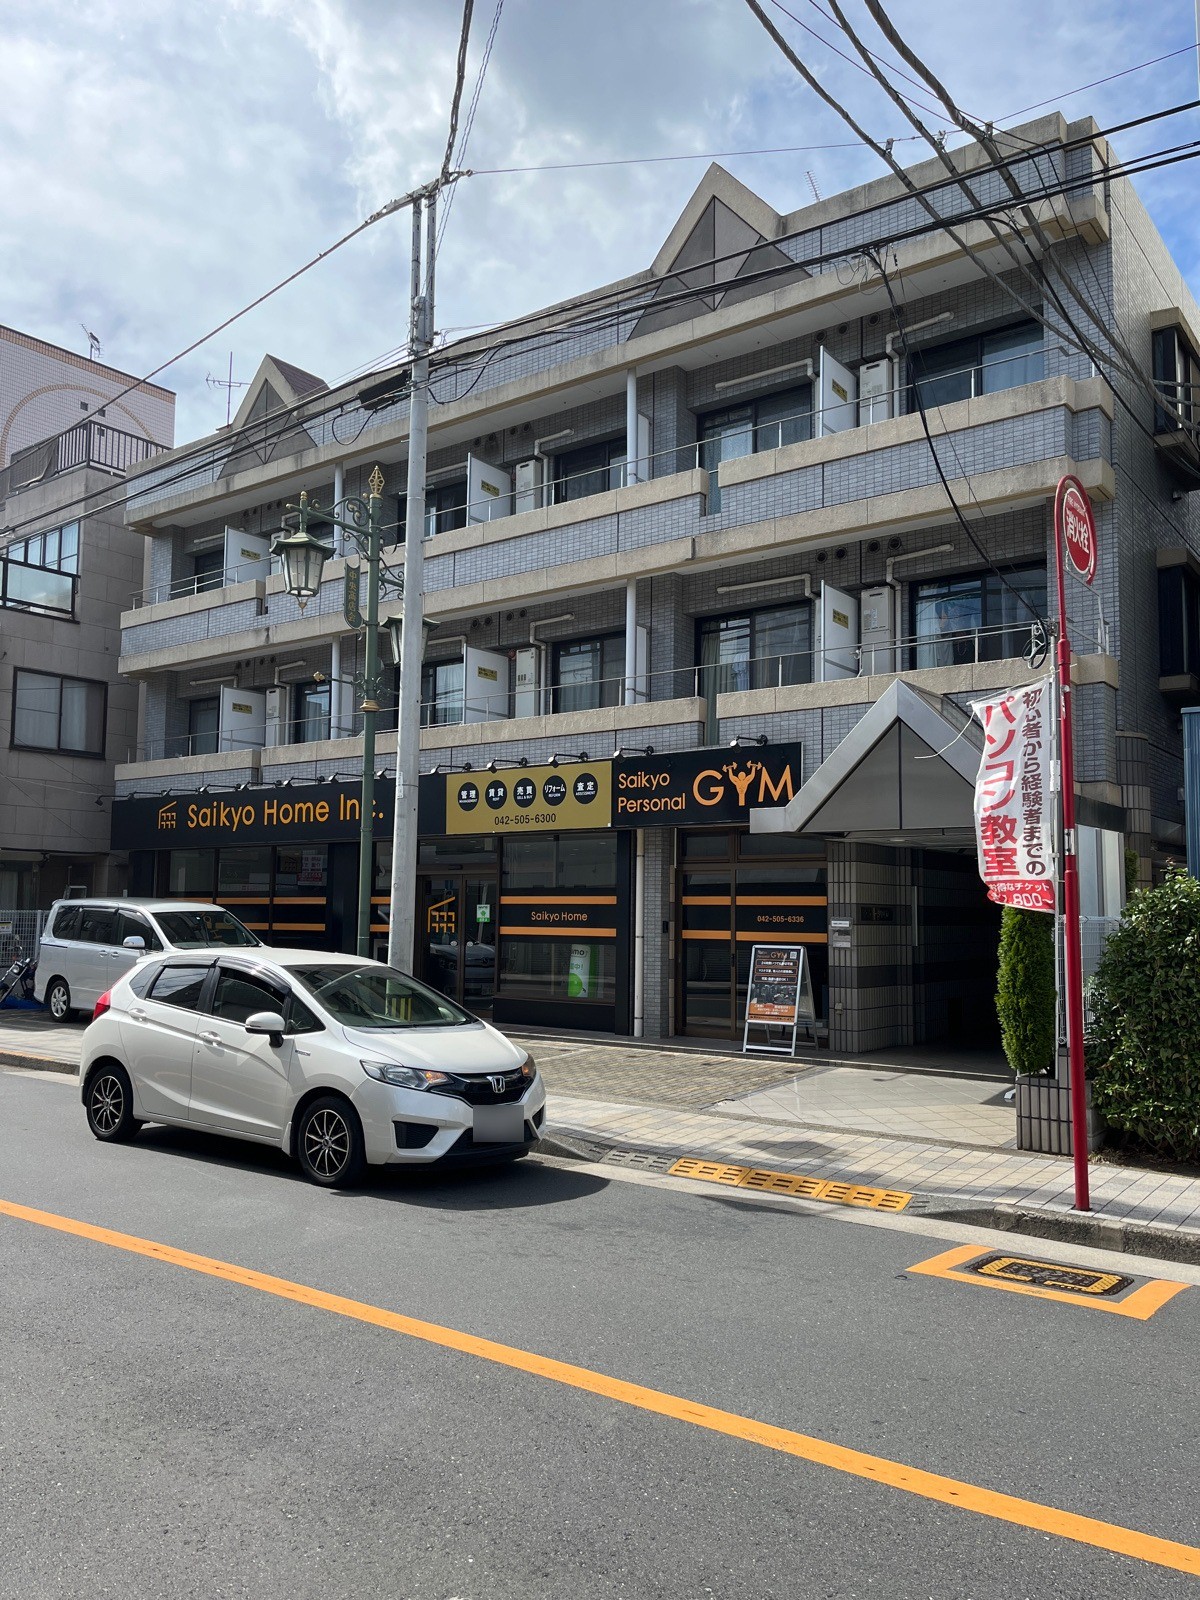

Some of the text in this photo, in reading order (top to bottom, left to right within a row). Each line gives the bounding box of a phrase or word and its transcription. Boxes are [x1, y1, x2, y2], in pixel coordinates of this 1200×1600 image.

[1066, 507, 1090, 554] 消火栓
[577, 781, 594, 791] 査定
[618, 771, 670, 790] Saikyo
[980, 695, 1020, 877] パソコン教室
[1021, 688, 1046, 876] 初心者から経験者までの
[488, 788, 504, 798] 賃貸
[516, 785, 533, 795] 売買
[544, 783, 566, 793] リフォーム
[460, 790, 476, 799] 管理
[618, 793, 686, 813] Personal
[187, 801, 255, 832] Saikyo
[263, 799, 330, 826] Home
[494, 813, 557, 825] 042-505-6300
[531, 911, 588, 923] Saikyo Home
